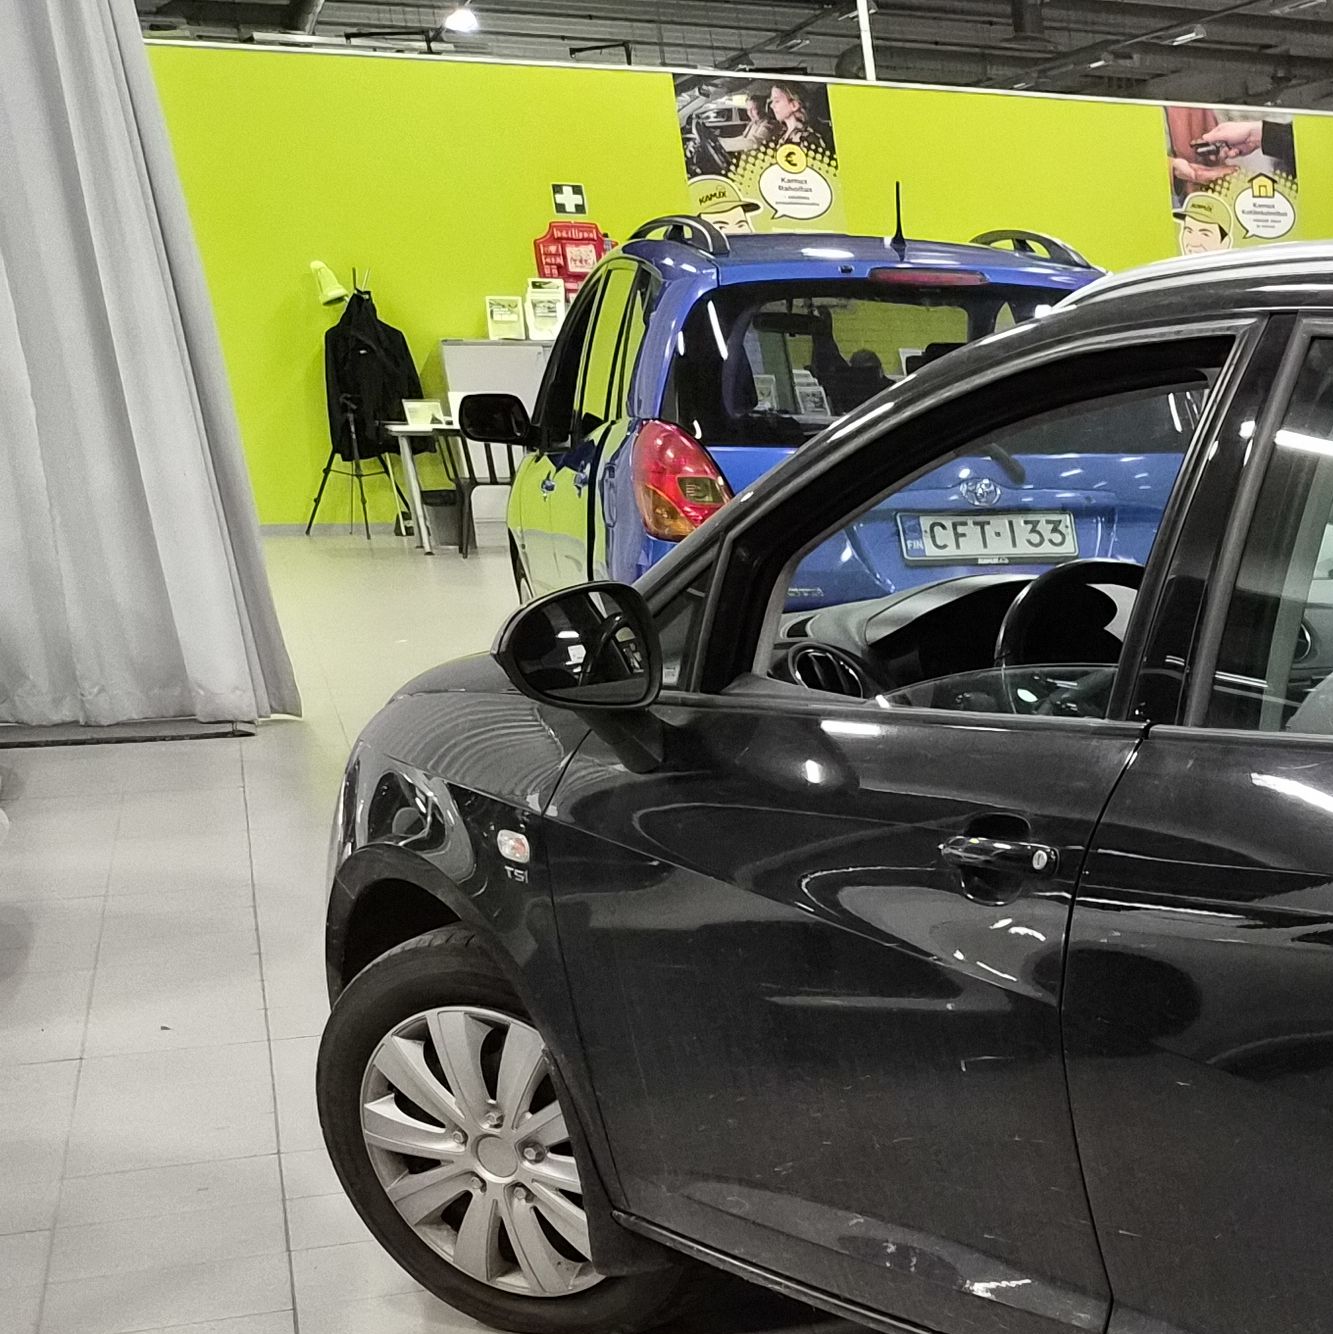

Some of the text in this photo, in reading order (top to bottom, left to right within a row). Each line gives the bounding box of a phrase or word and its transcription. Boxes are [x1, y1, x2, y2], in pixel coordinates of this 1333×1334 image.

[928, 519, 1067, 550] CFT-133
[906, 540, 925, 551] FIN
[504, 865, 529, 884] TSI
